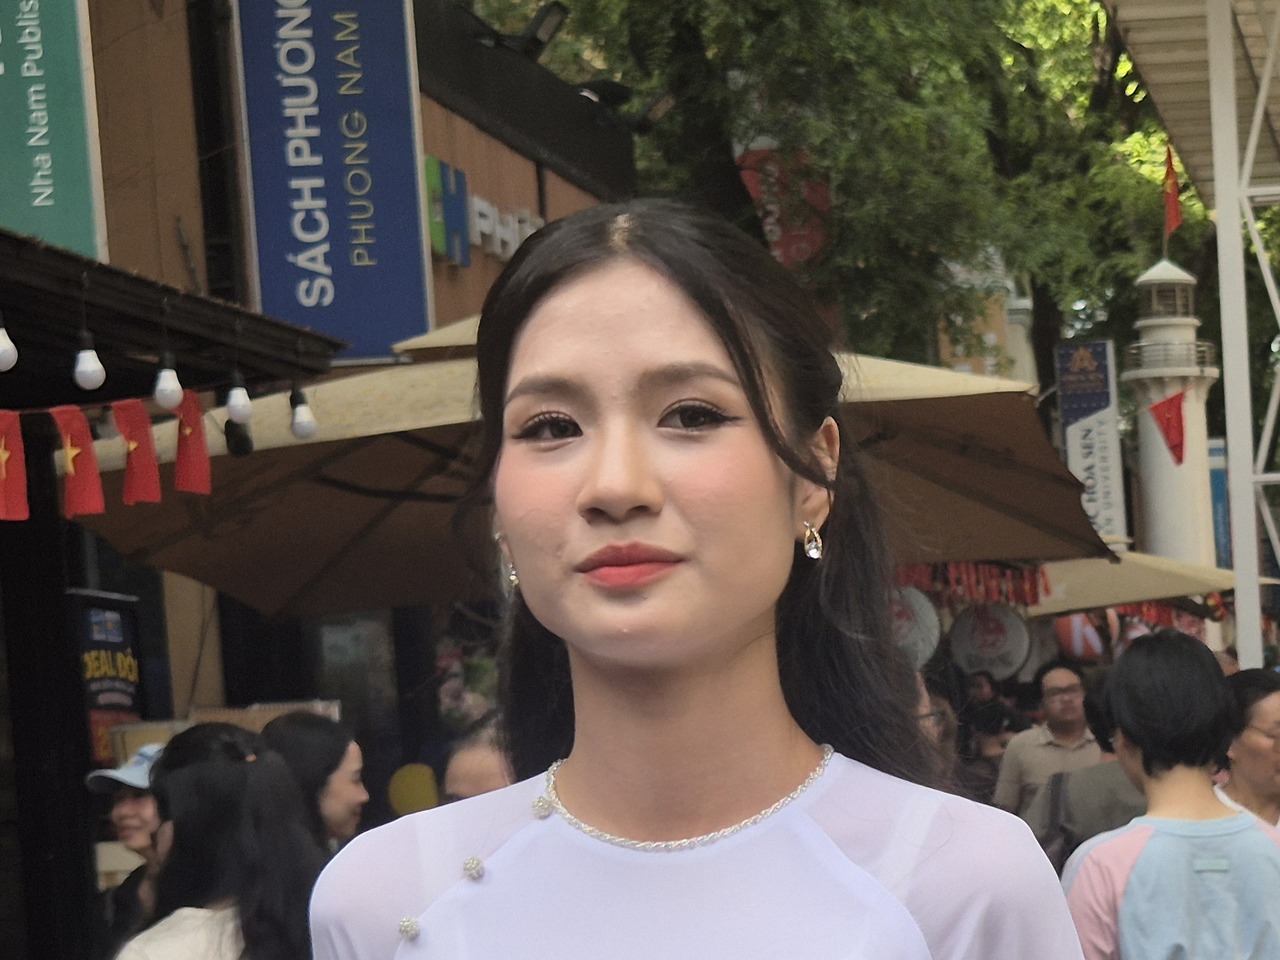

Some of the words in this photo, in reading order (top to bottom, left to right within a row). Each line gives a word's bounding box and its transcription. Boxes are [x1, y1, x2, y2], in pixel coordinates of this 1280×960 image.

[274, 0, 323, 167] PHƯƠN
[332, 11, 364, 95] NAM
[25, 83, 50, 146] Nam
[30, 153, 54, 207] Nha
[340, 110, 377, 266] PHUONG
[286, 178, 335, 307] SÁCH
